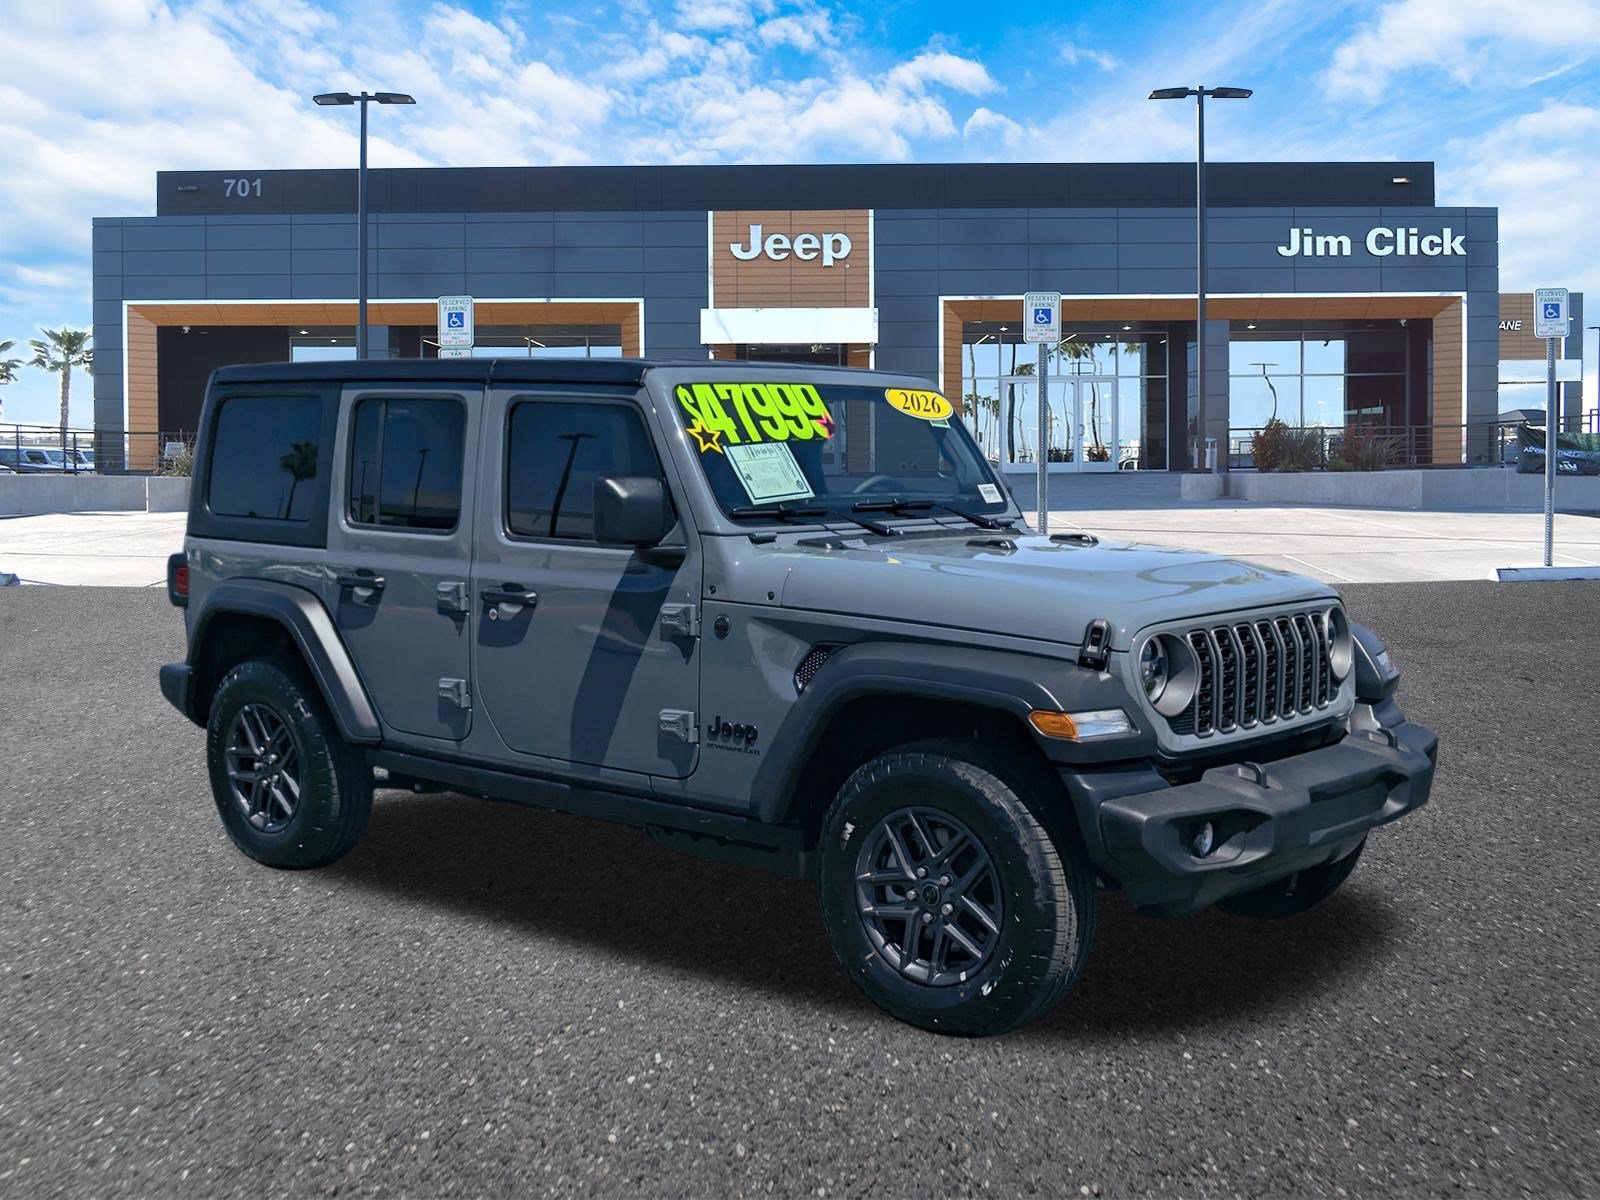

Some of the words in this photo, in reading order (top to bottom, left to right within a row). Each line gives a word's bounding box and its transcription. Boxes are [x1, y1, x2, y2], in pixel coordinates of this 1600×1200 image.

[223, 178, 263, 197] 701
[729, 223, 852, 267] Jeep
[1277, 227, 1352, 257] Jim
[1365, 227, 1468, 257] Click
[899, 391, 941, 414] 2026
[707, 715, 758, 745] Jeep
